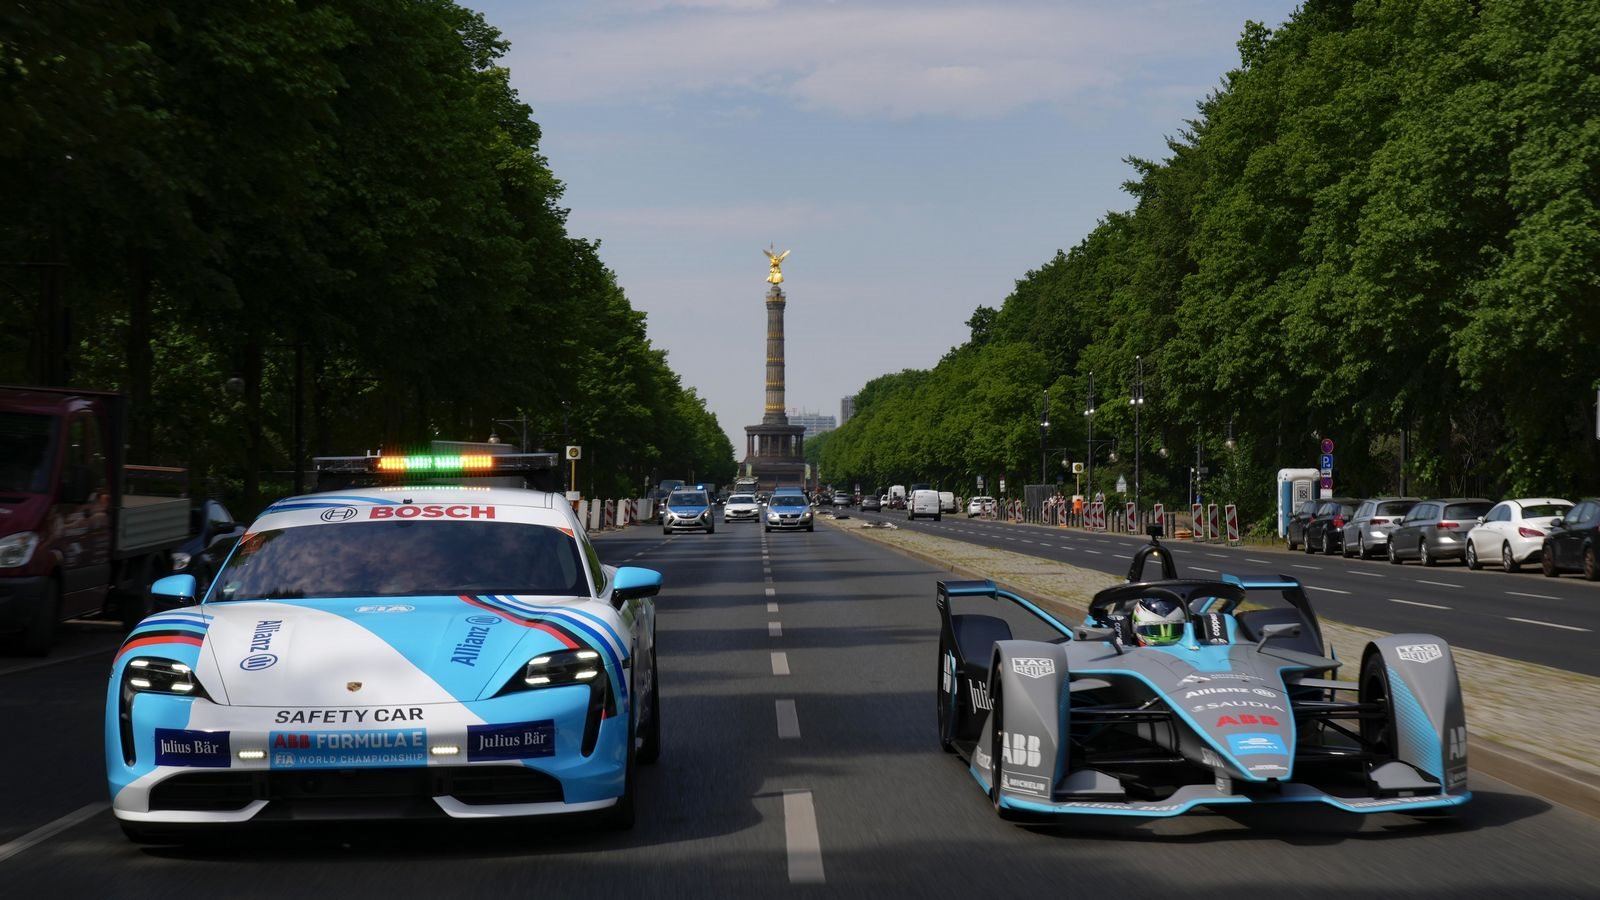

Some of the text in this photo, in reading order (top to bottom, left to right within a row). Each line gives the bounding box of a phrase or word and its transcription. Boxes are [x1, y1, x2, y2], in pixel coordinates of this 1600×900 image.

[370, 505, 496, 519] BOSCH
[357, 605, 410, 613] FIA
[250, 619, 283, 653] Allianz
[450, 624, 490, 667] Allianz
[1015, 659, 1050, 667] TAG
[1015, 666, 1052, 677] HEUER
[968, 678, 995, 715] Juli
[1185, 687, 1251, 699] Allianz
[1206, 700, 1287, 713] SAUDIA
[274, 707, 425, 724] SAFETY CAR
[1216, 714, 1281, 728] ABB
[160, 739, 220, 756] Julius Bär
[273, 731, 424, 750] ABB FORMULA E
[479, 731, 548, 751] Julius Bär
[1002, 732, 1041, 768] ABB
[275, 752, 424, 766] FIA WORLD CHAMPIONSHIP
[1008, 778, 1046, 791] MICHELIN
